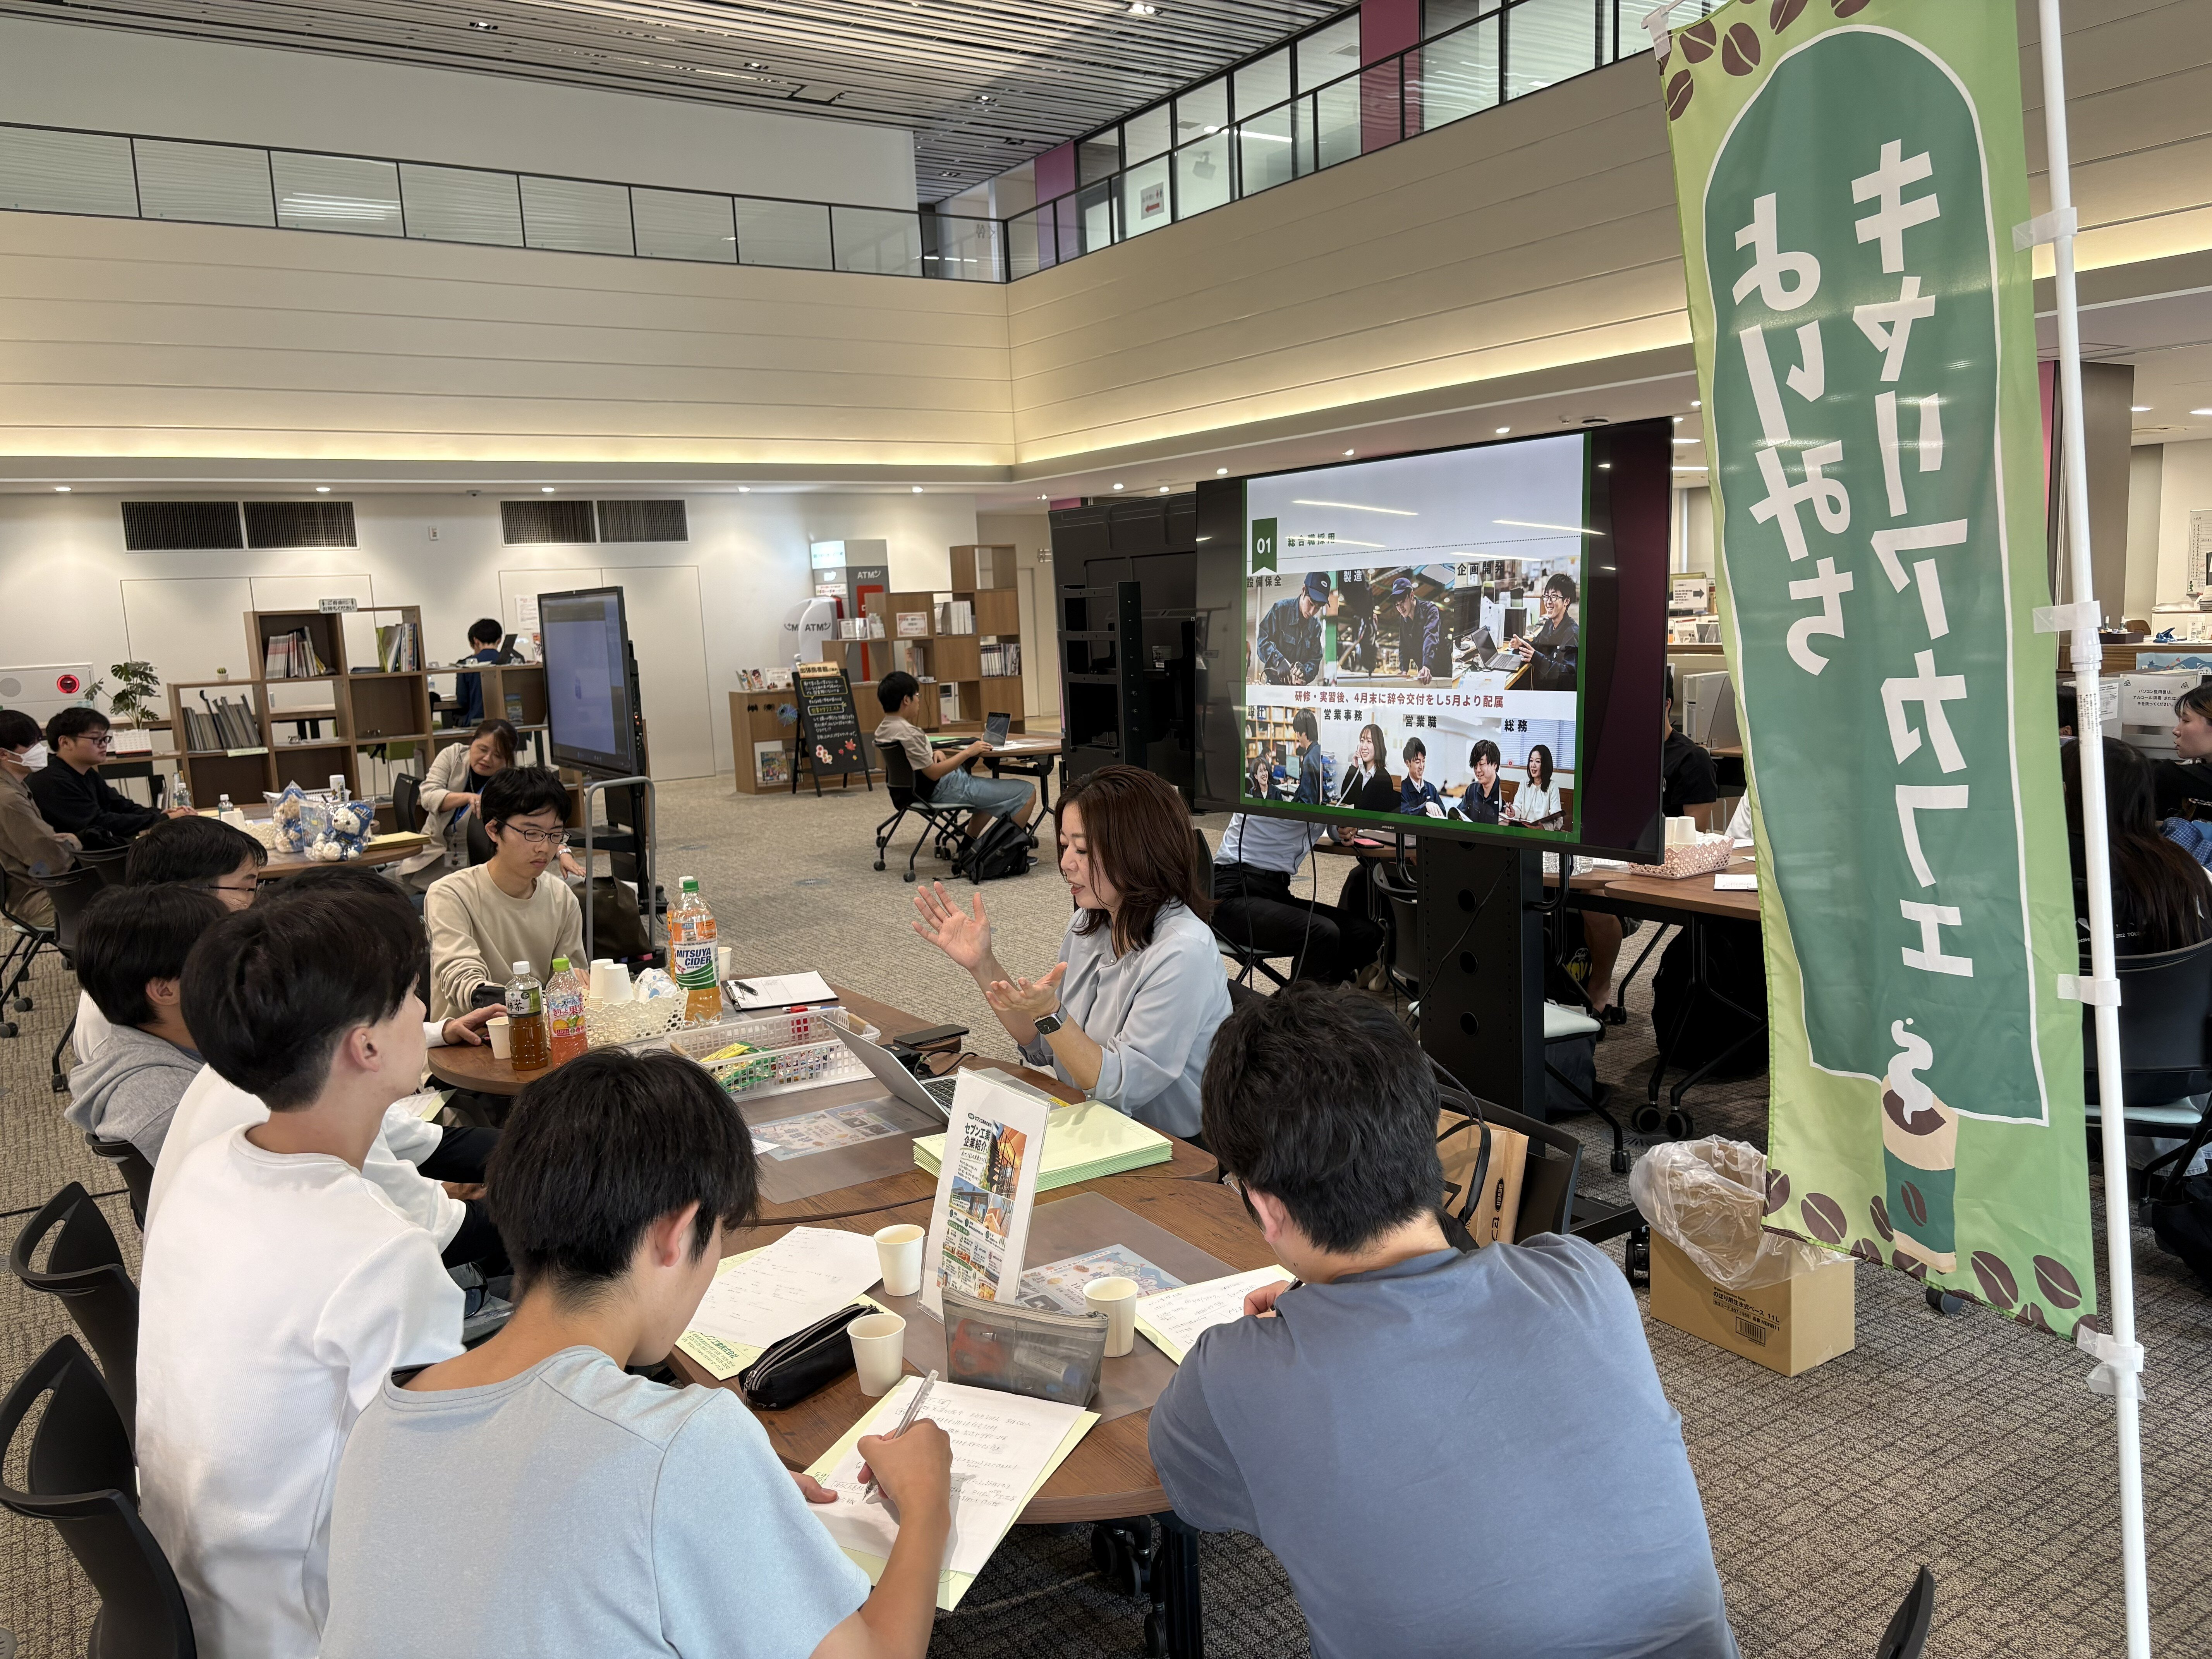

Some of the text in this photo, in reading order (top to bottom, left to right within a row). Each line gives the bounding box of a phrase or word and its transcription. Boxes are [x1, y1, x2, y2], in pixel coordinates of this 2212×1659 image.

[1257, 538, 1271, 554] 01
[1288, 533, 1335, 547] 総合職採用
[857, 571, 875, 579] ATM
[1343, 570, 1363, 582] 製造
[1457, 562, 1504, 576] 企画開発
[1247, 575, 1281, 588] 設備保全
[805, 623, 824, 632] ATM
[1248, 705, 1264, 719] 設計
[1324, 709, 1363, 721] 営業事務
[1405, 714, 1437, 729] 営業職
[1504, 719, 1528, 733] 総務
[677, 947, 711, 958] MITSUYA
[685, 955, 711, 966] CIDER
[965, 1122, 991, 1142] セブン工業
[963, 1135, 987, 1153] 企業紹介
[1713, 1291, 1780, 1323] のぼり用注水式ベース 11L
